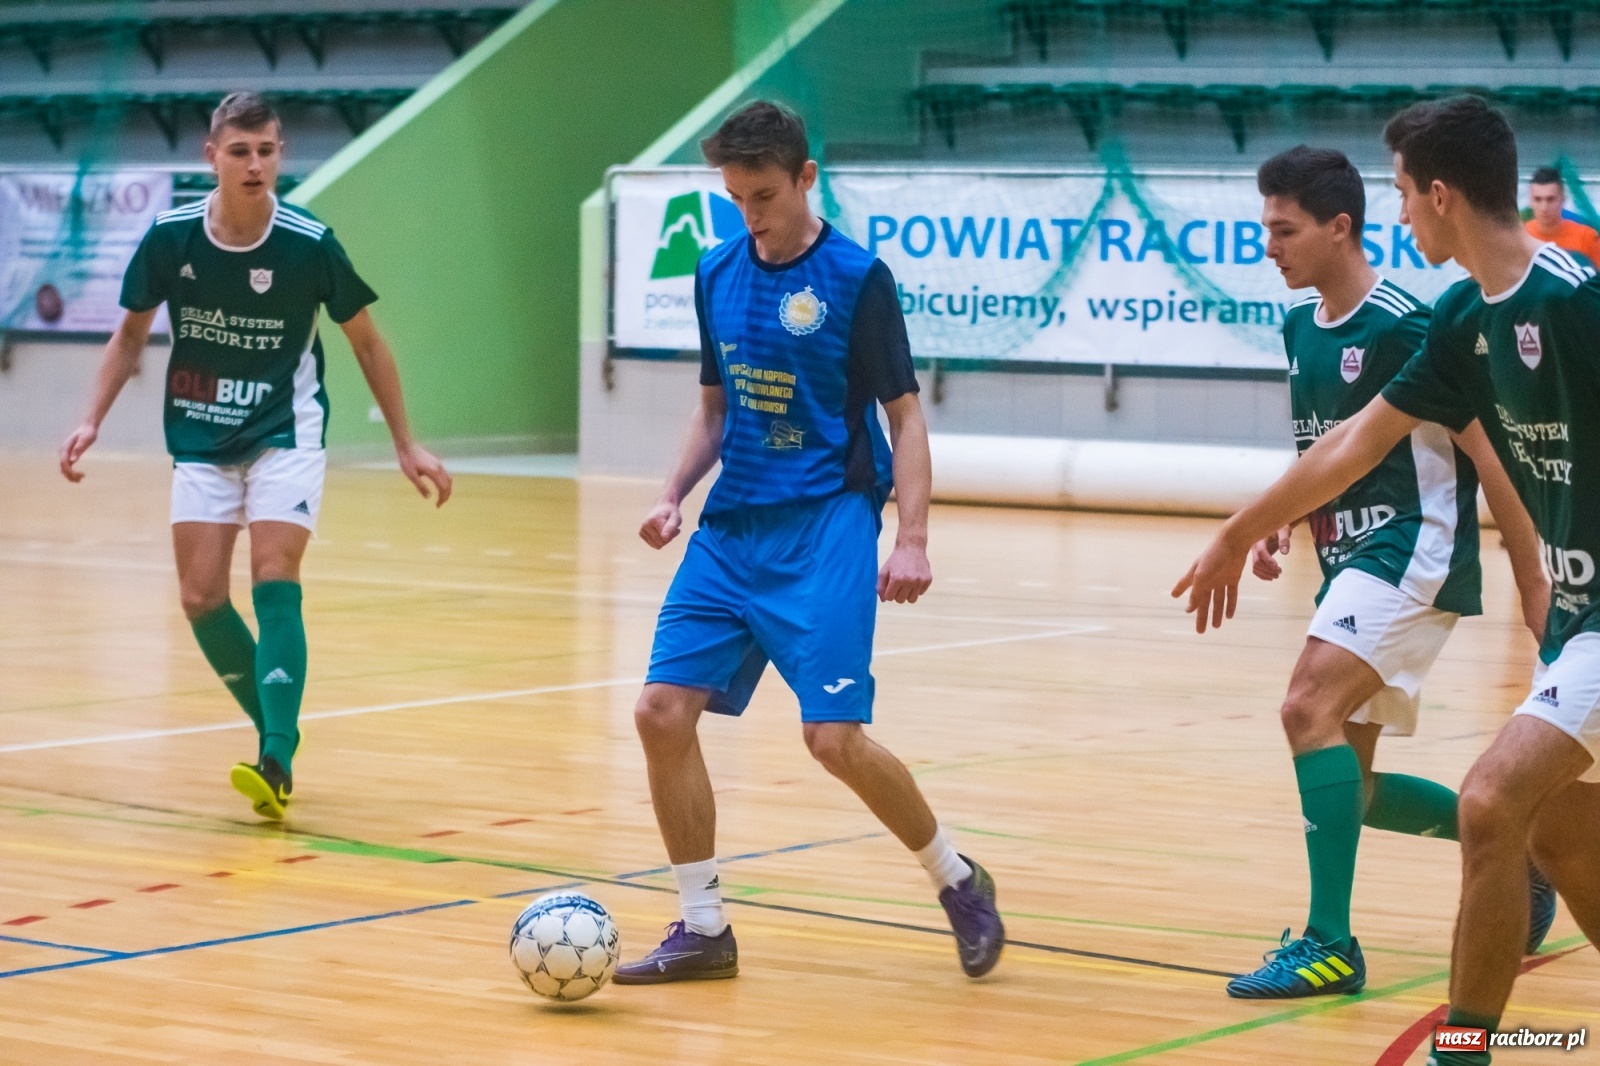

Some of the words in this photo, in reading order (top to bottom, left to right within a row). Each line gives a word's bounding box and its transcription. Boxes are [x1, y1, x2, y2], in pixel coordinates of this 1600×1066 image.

[868, 215, 1084, 264] POWIAT
[645, 292, 696, 315] powi
[896, 282, 1066, 328] bicujemy,
[179, 324, 284, 350] SECURITY
